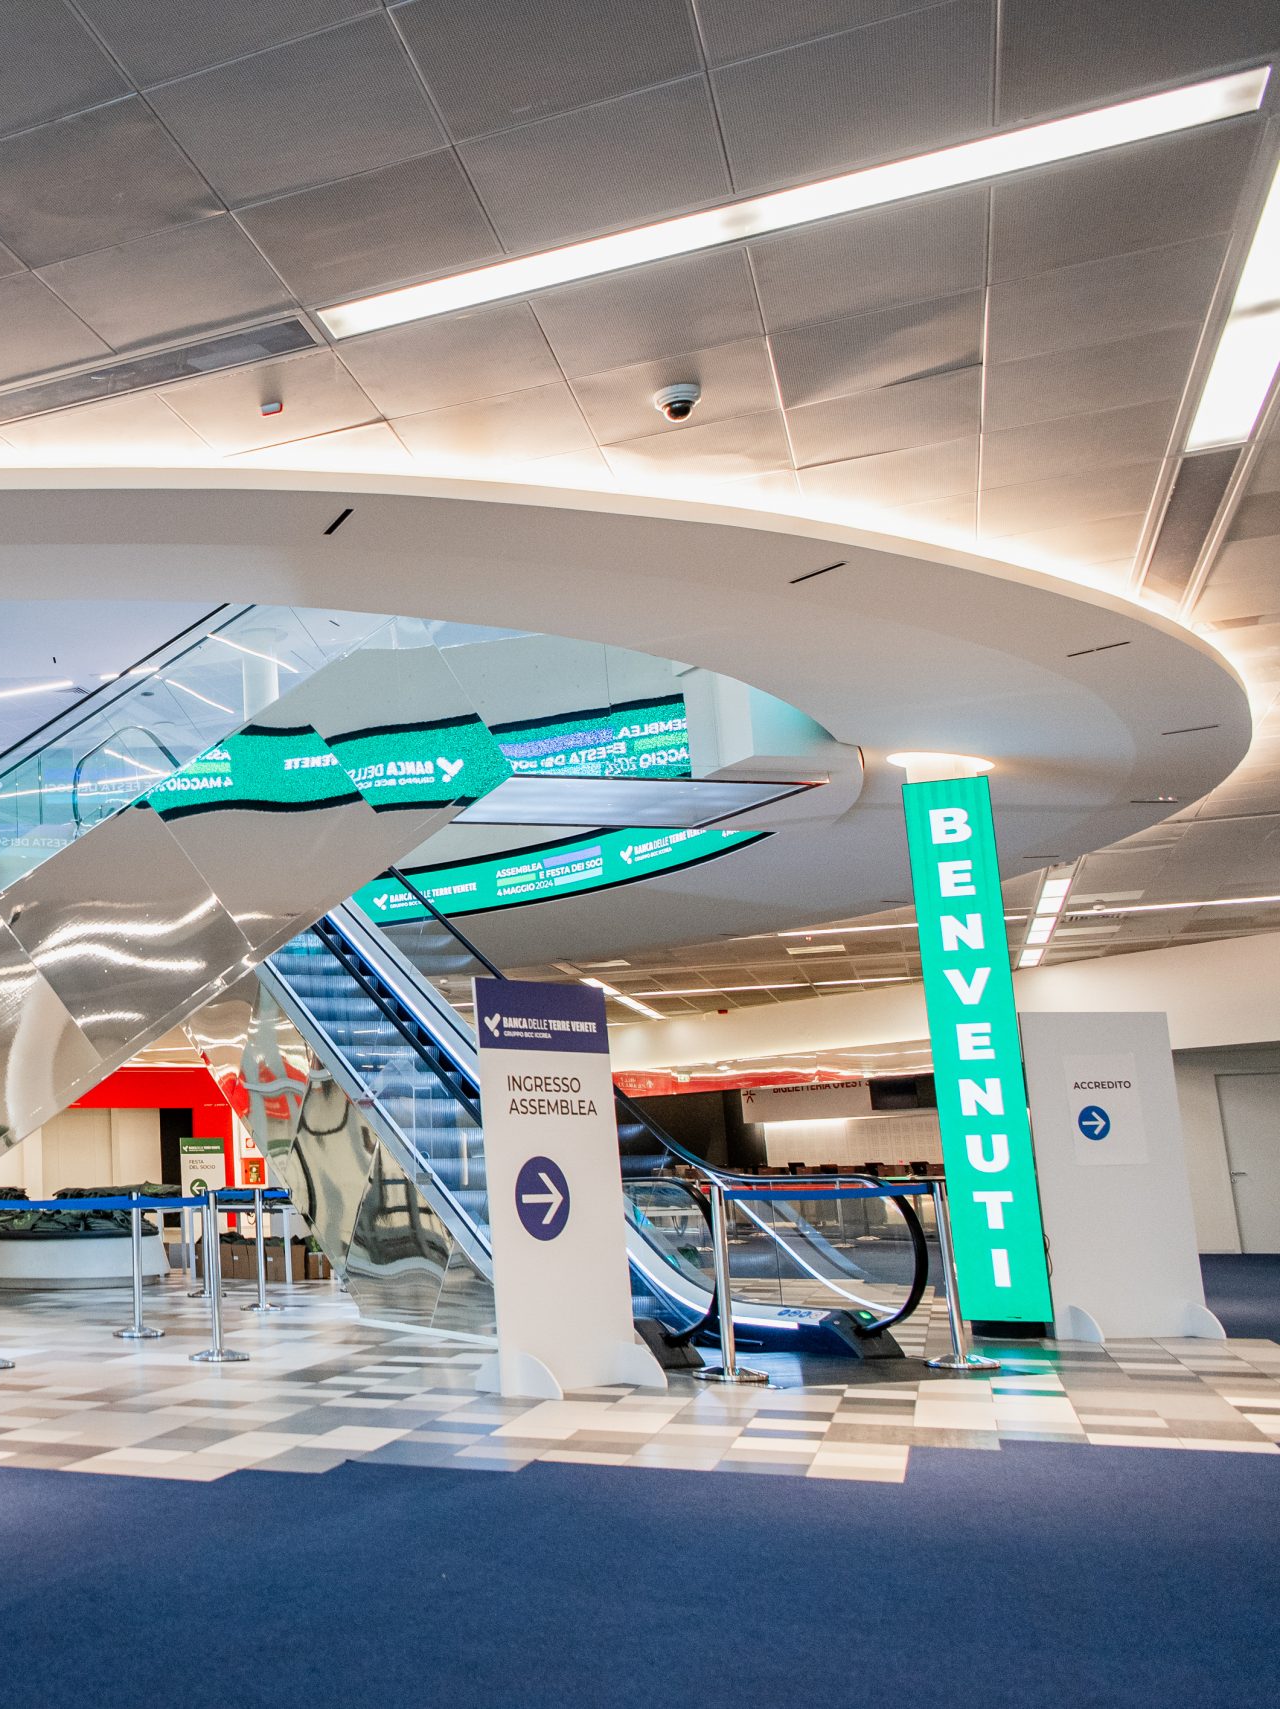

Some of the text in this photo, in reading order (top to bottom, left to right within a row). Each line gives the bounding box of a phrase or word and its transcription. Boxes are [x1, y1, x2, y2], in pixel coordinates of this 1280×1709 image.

[496, 862, 543, 878] ASSEMBLEA
[546, 867, 570, 878] FESTA
[572, 863, 585, 872] DEI
[586, 858, 603, 870] SOCI
[390, 892, 413, 903] BANCA
[453, 882, 477, 894] VENETE
[496, 880, 553, 897] 4 MAGGIO 2024
[503, 1017, 597, 1033] BANCA DELLE TERRE VENETE
[928, 807, 1014, 1287] BENVENUTI
[507, 1075, 581, 1093] INGRESSO
[1073, 1080, 1131, 1089] ACCREDITO
[509, 1098, 597, 1116] ASSEMBLEA
